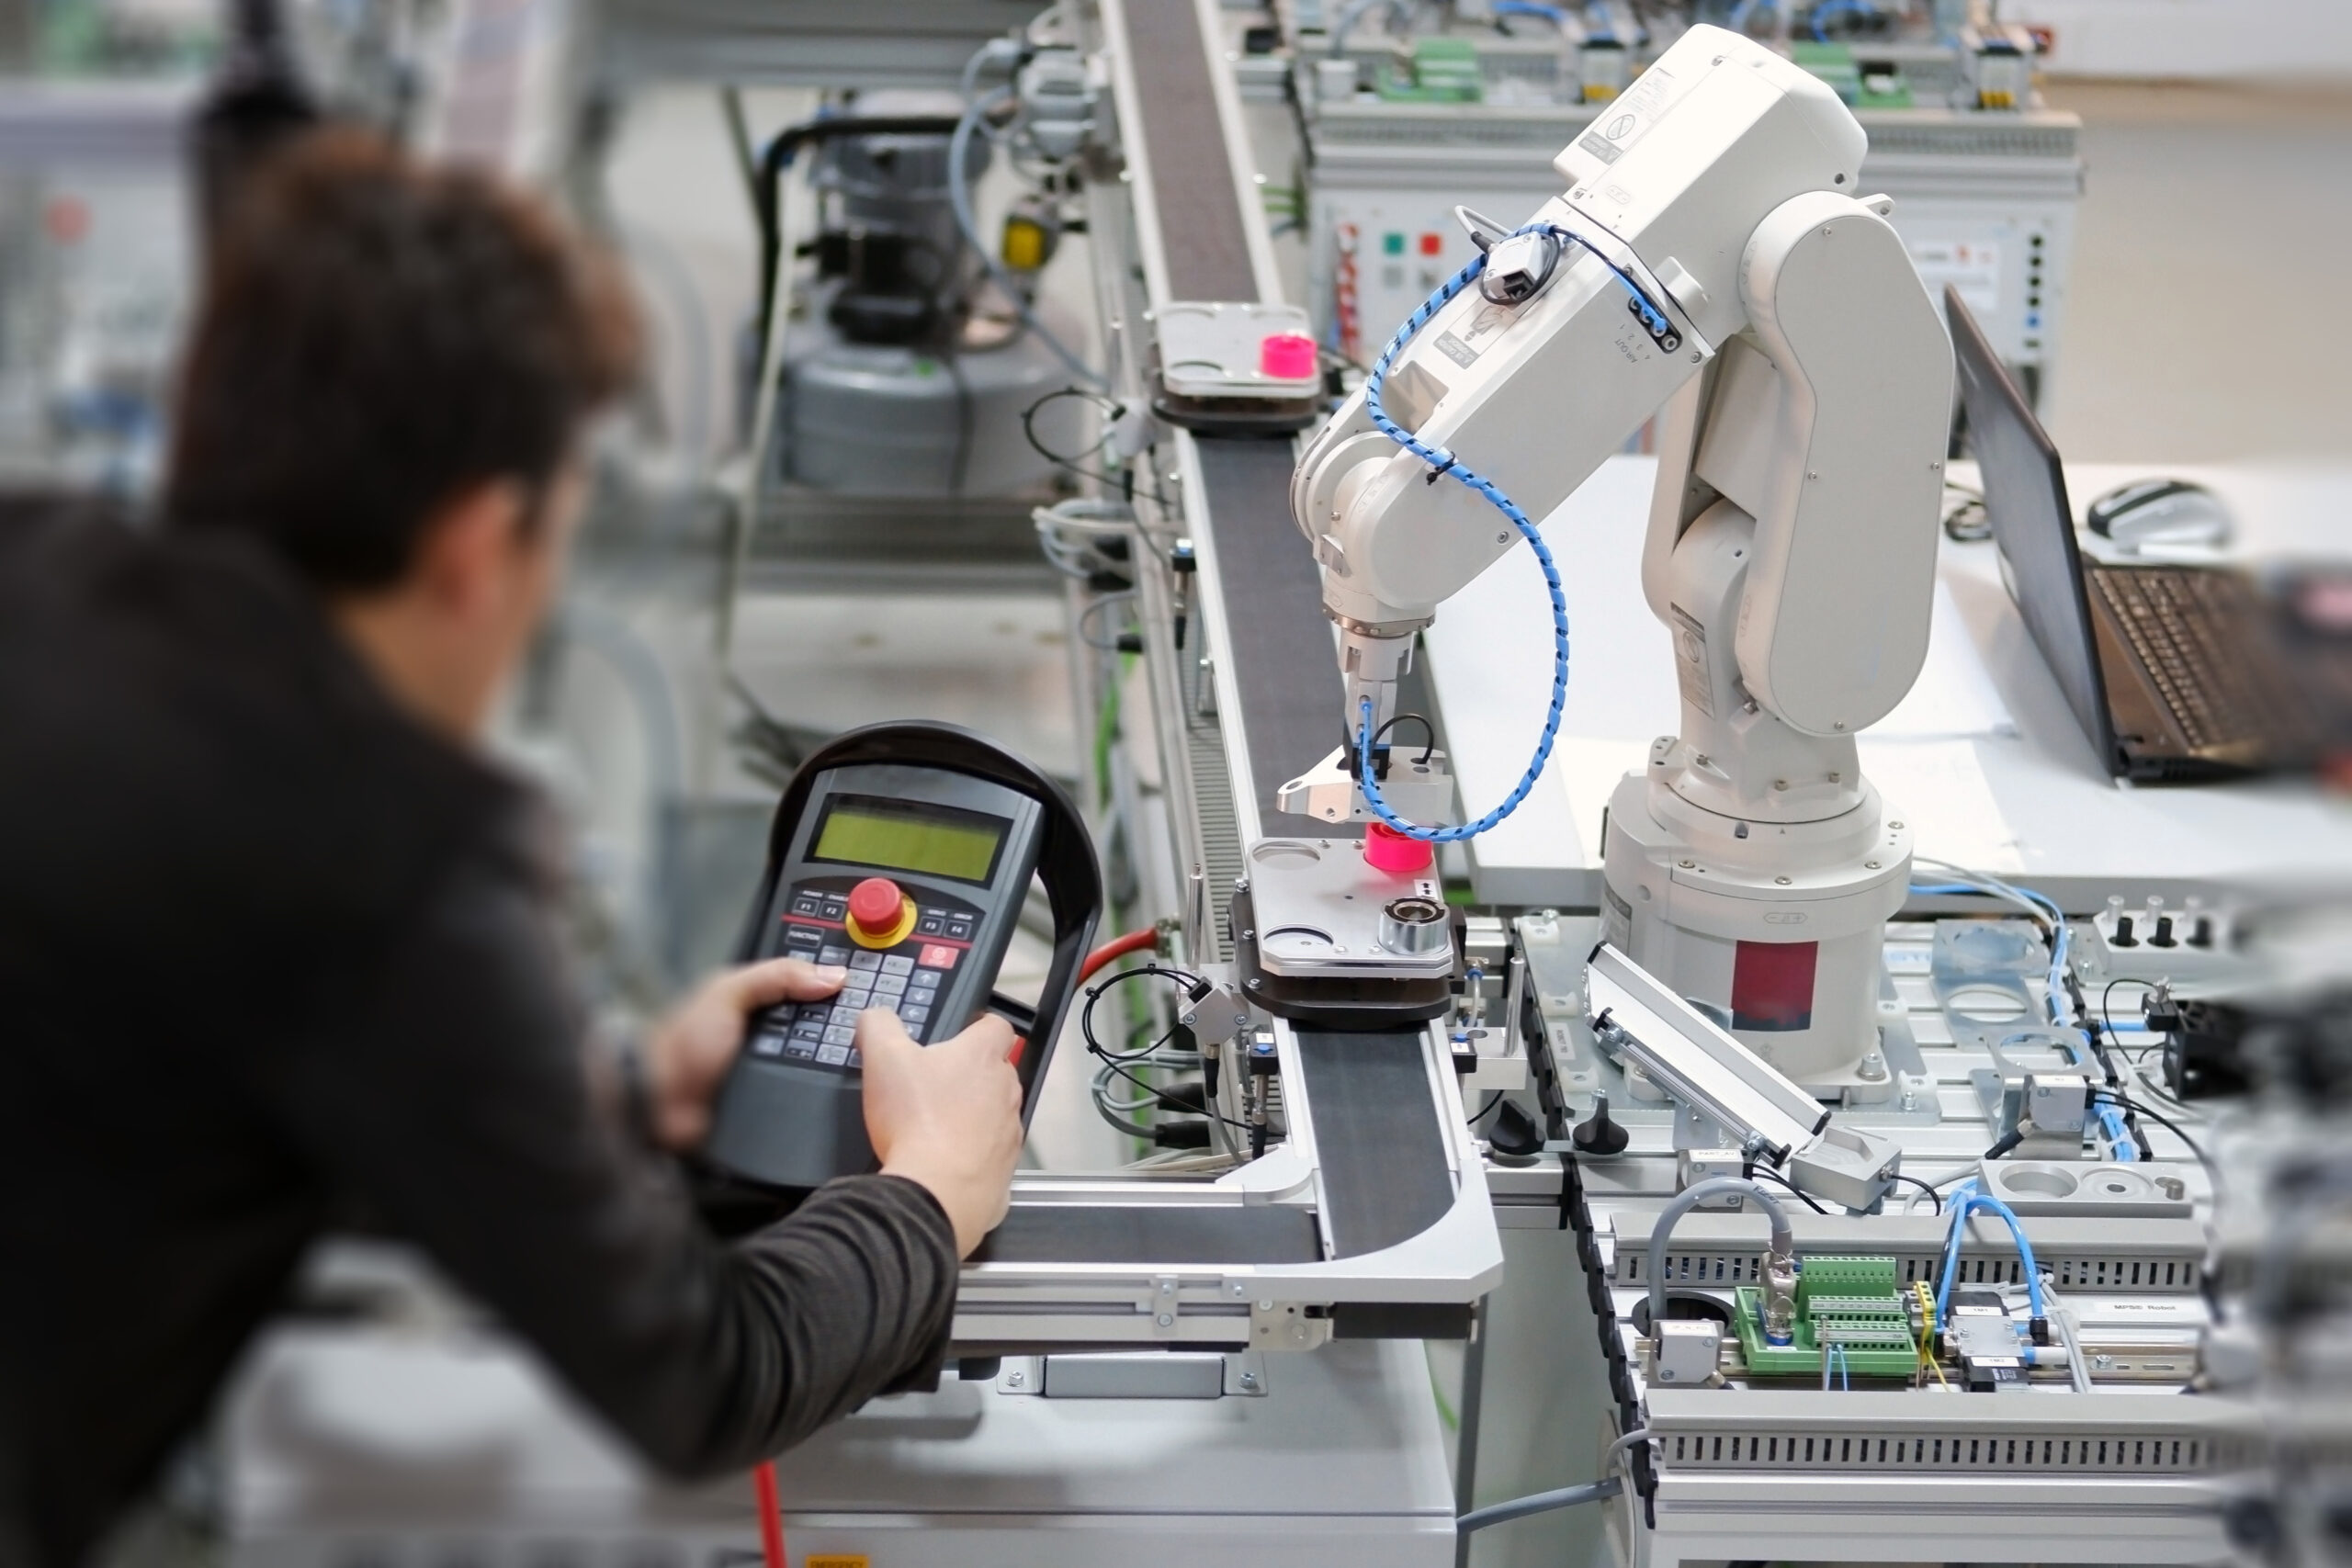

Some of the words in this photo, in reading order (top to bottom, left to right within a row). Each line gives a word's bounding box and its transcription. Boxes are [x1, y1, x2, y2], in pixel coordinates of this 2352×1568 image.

[827, 907, 837, 915] F2
[926, 921, 936, 930] F3
[790, 931, 820, 941] FUNCTION
